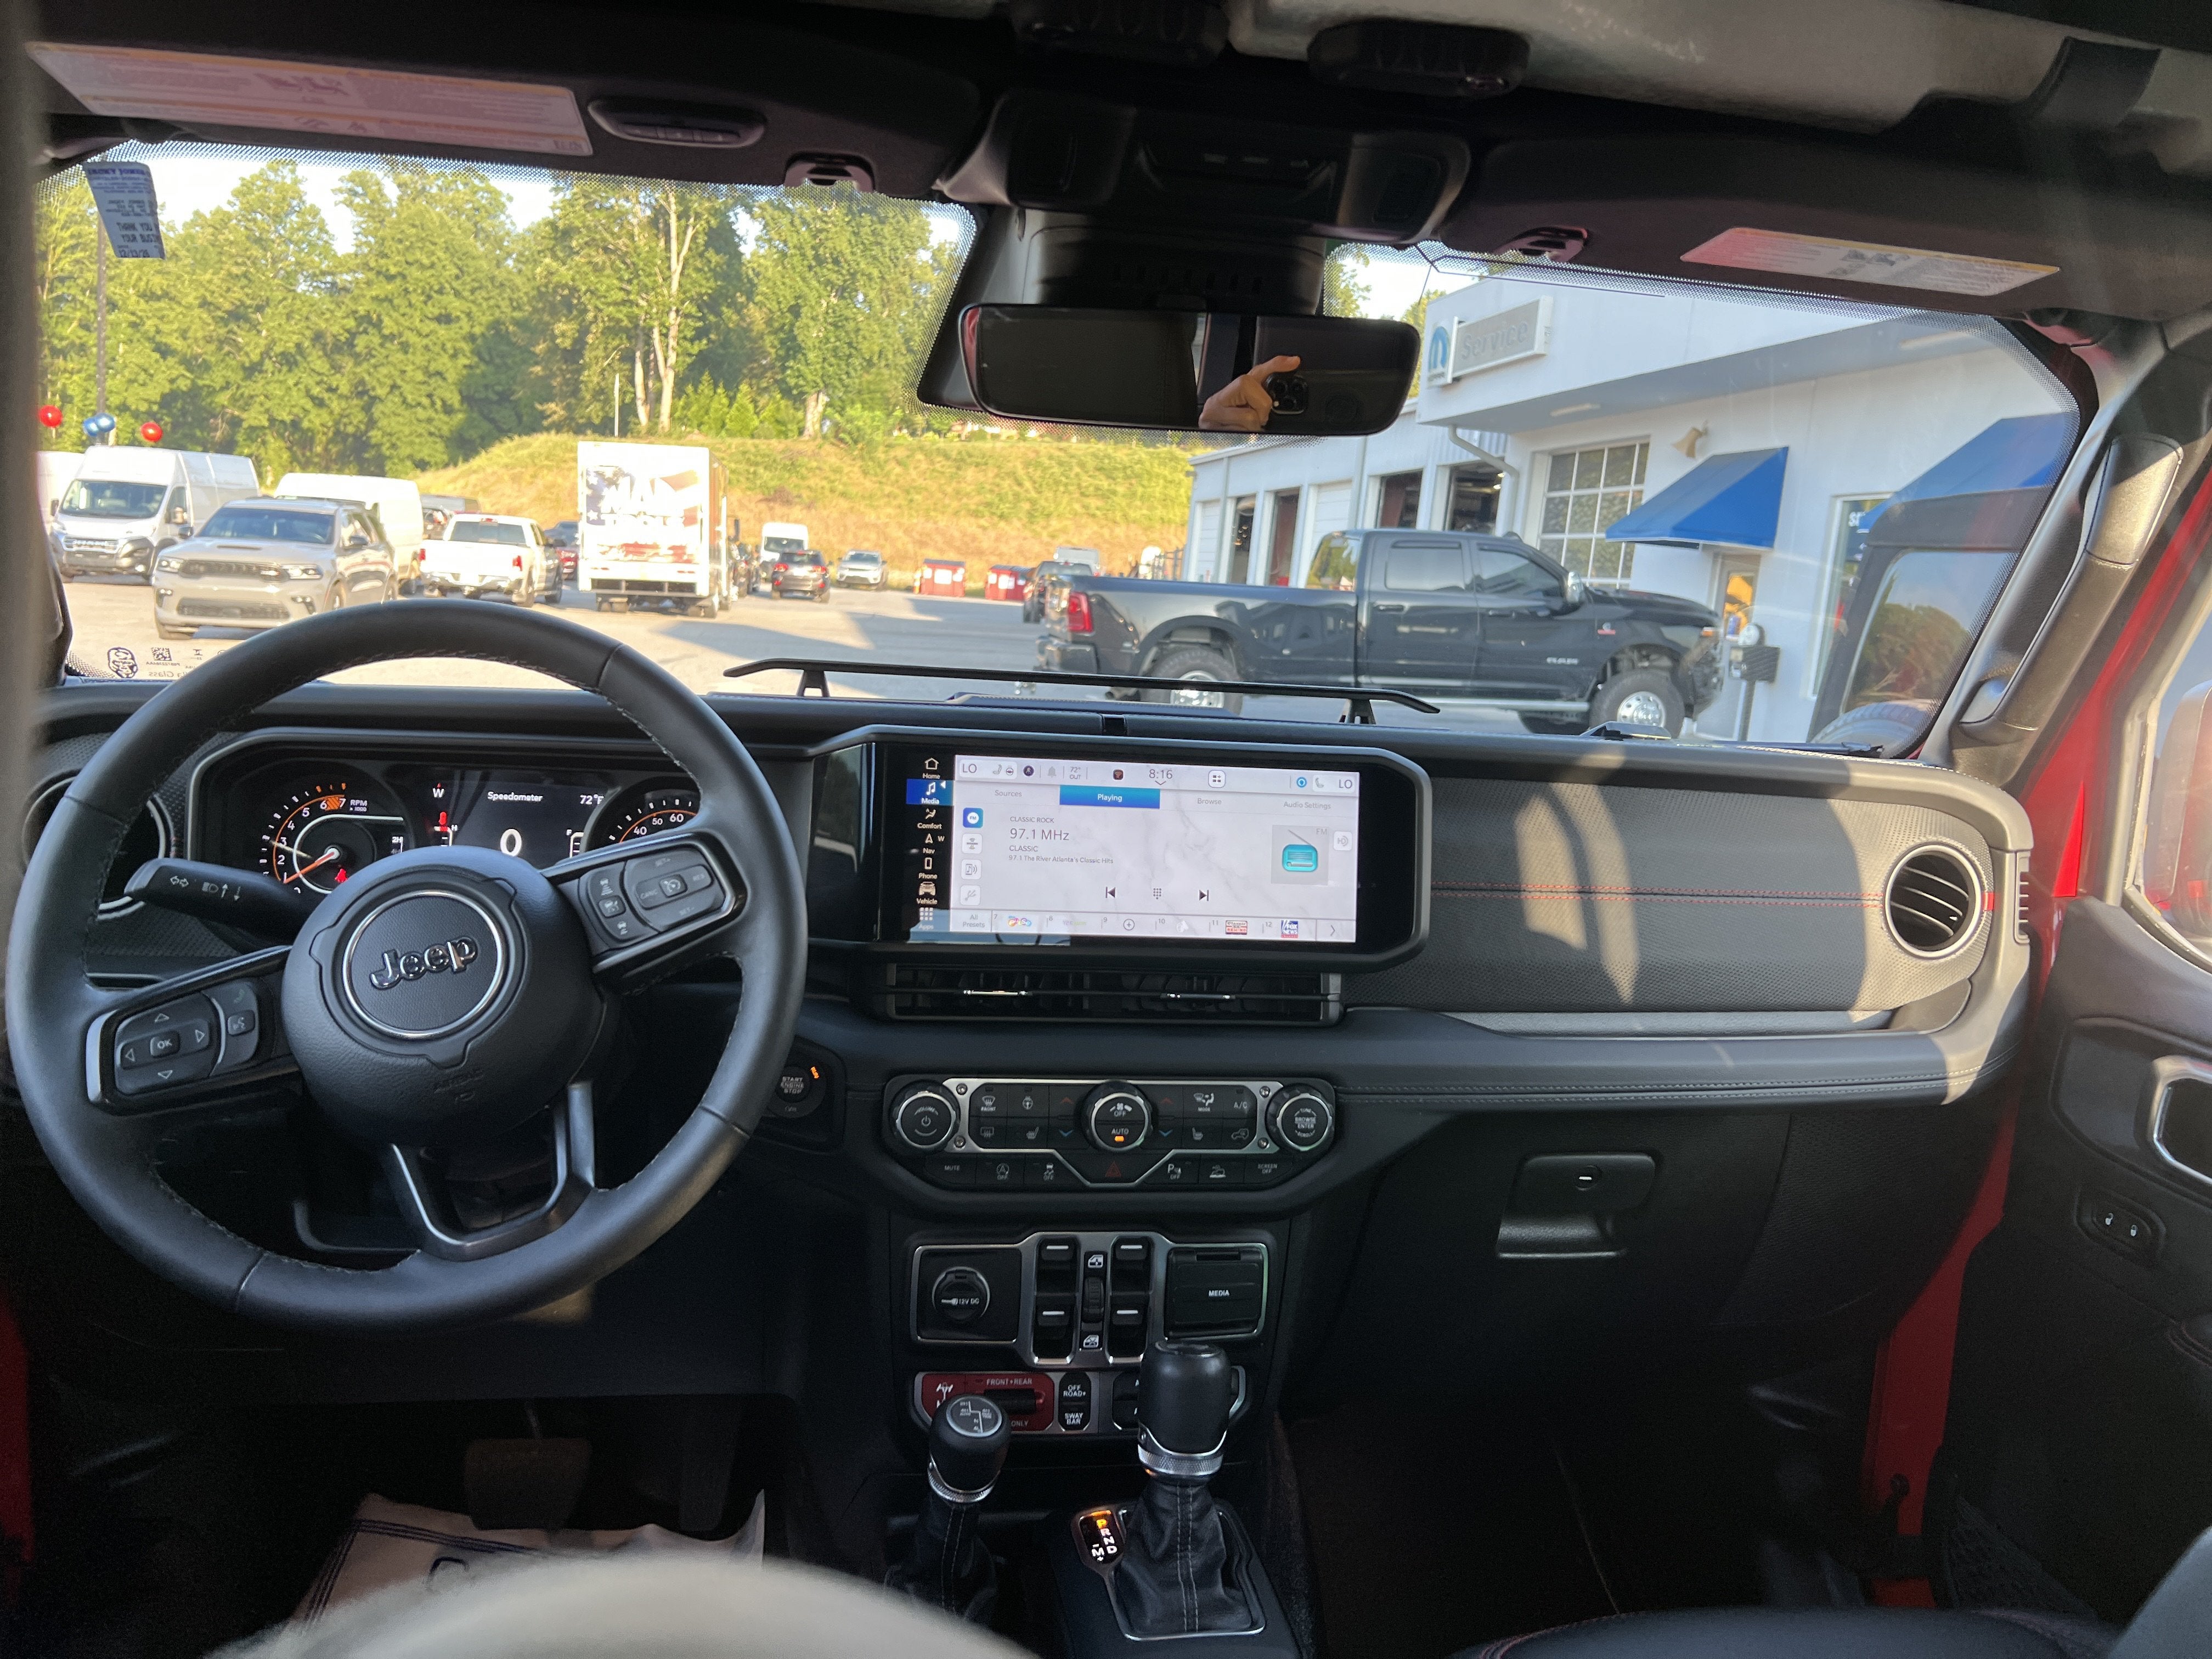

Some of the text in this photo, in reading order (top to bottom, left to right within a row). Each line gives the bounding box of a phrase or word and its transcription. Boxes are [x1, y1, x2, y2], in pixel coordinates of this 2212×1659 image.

[1462, 321, 1528, 359] Service
[962, 763, 977, 774] LO
[1149, 769, 1173, 780] 8:16
[1338, 779, 1353, 789] LO
[432, 788, 444, 798] W
[487, 792, 543, 802] Speedometer
[1097, 793, 1122, 803] Playing
[320, 800, 328, 809] 6
[338, 798, 346, 808] 7
[1304, 802, 1331, 810] Settings
[302, 808, 310, 817] 5
[669, 813, 684, 822] 60
[287, 821, 295, 830] 4
[633, 826, 647, 836] 40
[1009, 828, 1070, 841] 97.1 MHz
[280, 837, 287, 847] 3
[500, 828, 522, 857] 0
[277, 854, 285, 865] 2
[369, 936, 479, 990] Jeep
[157, 1039, 173, 1049] OK
[1096, 1519, 1107, 1529] P
[1100, 1528, 1111, 1536] R
[1103, 1536, 1115, 1545] N
[1091, 1547, 1105, 1557] M
[1106, 1545, 1118, 1554] D
